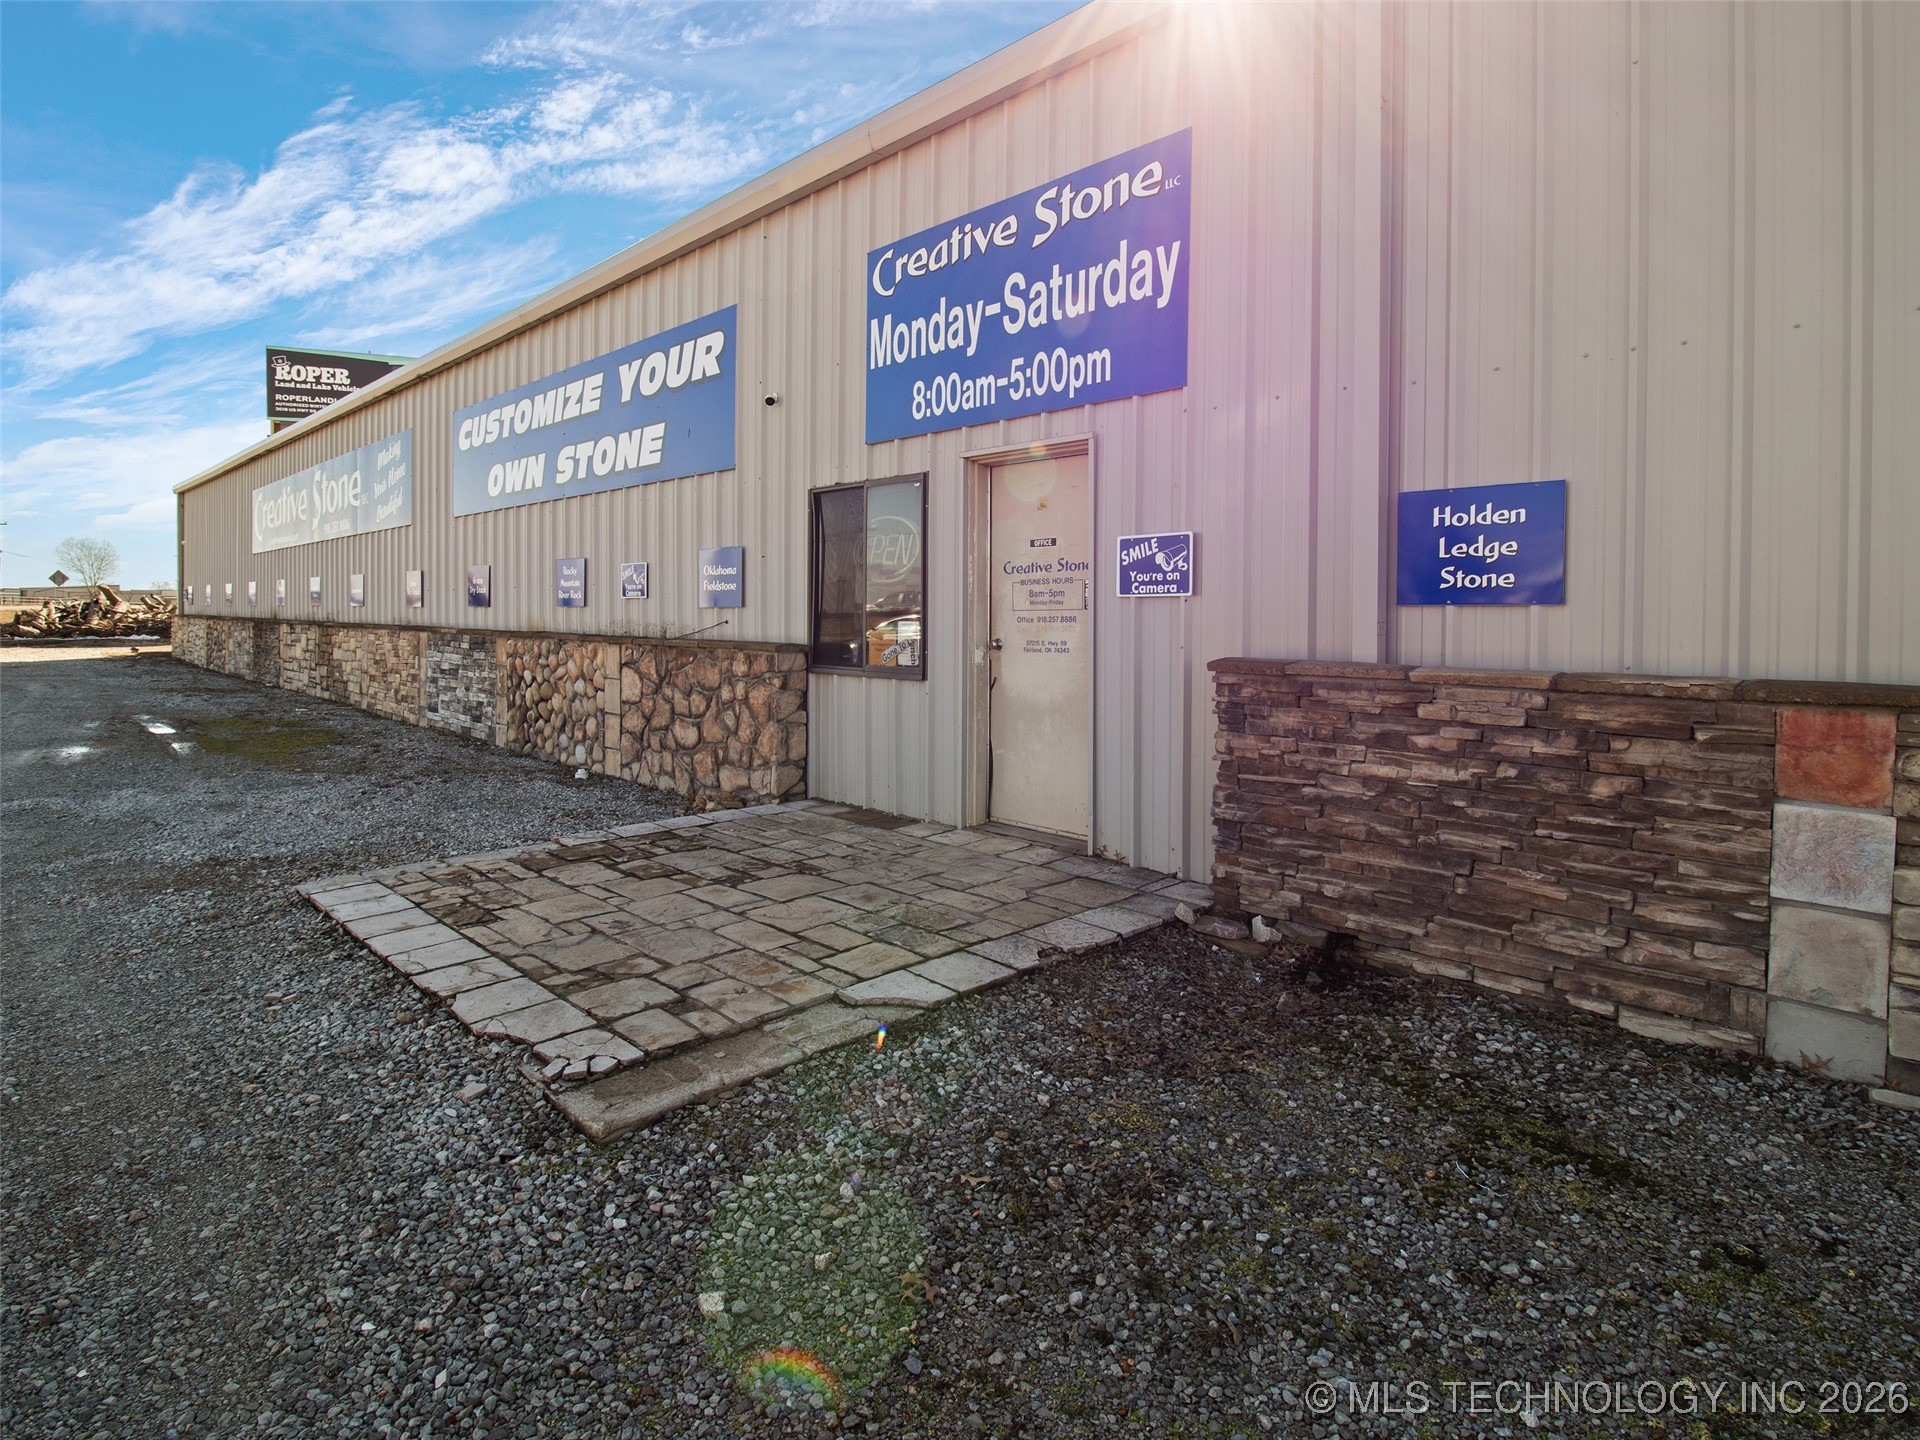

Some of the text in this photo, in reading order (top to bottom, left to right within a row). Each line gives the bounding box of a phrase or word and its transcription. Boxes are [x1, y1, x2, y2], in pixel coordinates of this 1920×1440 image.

[872, 161, 1181, 297] Creative Stone LLC
[870, 239, 1181, 370] Monday-Saturday
[274, 365, 351, 385] ROPER
[912, 347, 1111, 420] 8:00am-5:00pm
[458, 331, 725, 451] CUSTOMIZE YOUR
[487, 422, 666, 497] OWN STONE
[255, 486, 307, 541] Creative
[312, 468, 361, 531] Stone
[1433, 502, 1526, 528] Holden
[1033, 539, 1053, 547] OFFICE
[1121, 537, 1159, 566] SMILE
[1438, 534, 1519, 563] Ledge
[562, 566, 578, 577] Rocky
[703, 565, 737, 576] Oklahoma
[1003, 560, 1052, 575] Creative
[1129, 571, 1180, 581] You're on
[1439, 566, 1516, 589] Stone
[703, 580, 737, 591] Fieldstone
[1020, 577, 1074, 586] BUSINESS HOURS
[1131, 582, 1178, 594] Camera
[1029, 589, 1065, 598] 8am-5pm
[882, 648, 898, 662] Gone
